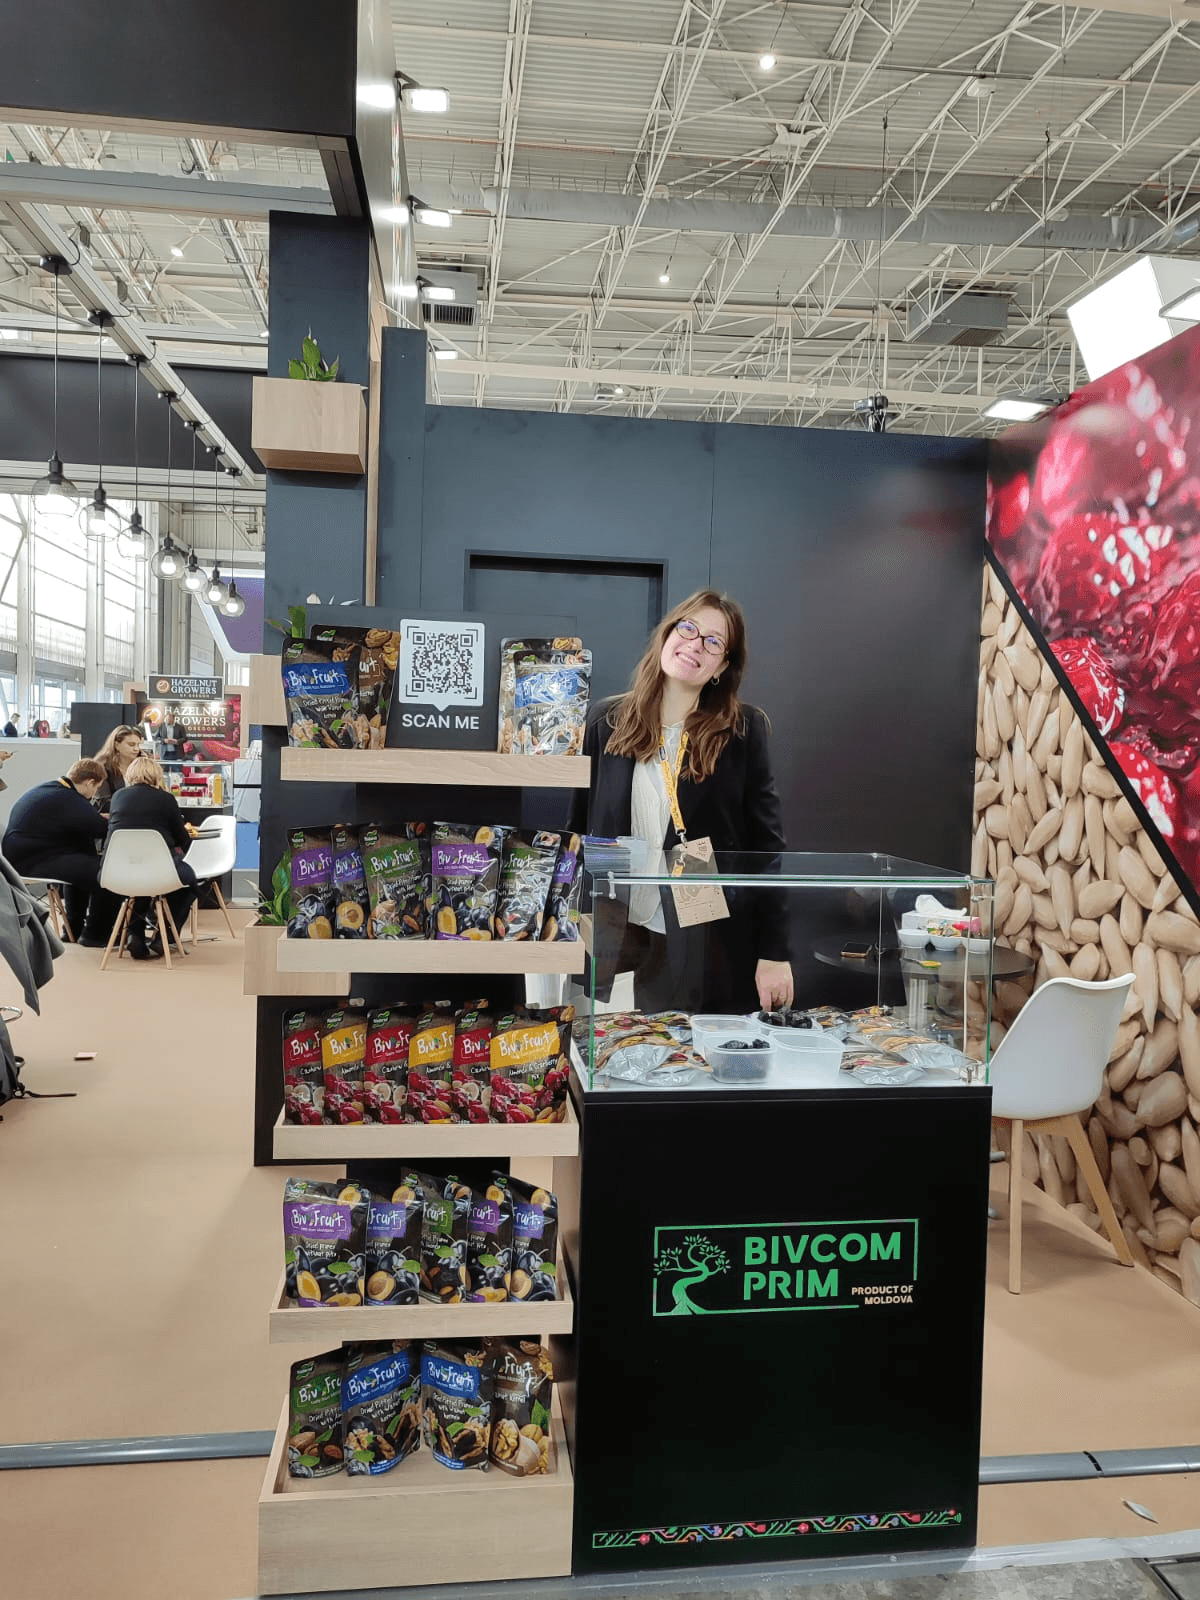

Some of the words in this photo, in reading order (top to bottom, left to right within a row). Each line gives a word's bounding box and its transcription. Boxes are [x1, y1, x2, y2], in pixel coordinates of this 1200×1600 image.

[360, 657, 377, 673] uit
[171, 678, 218, 688] HAZELNUT
[312, 669, 339, 684] Fruit
[171, 686, 217, 695] GROWERS
[164, 706, 227, 716] HAZELNUT
[402, 713, 450, 729] SCAN
[455, 716, 480, 730] ME
[393, 848, 414, 864] Fruit
[457, 849, 482, 864] Fruit
[510, 853, 533, 868] Fruit
[523, 1030, 550, 1050] Fruit
[314, 1210, 343, 1227] Fruit
[370, 1208, 398, 1225] Fruit
[423, 1202, 446, 1221] Fruit
[473, 1205, 493, 1220] ruit
[744, 1232, 901, 1265] BIVCOM
[743, 1269, 839, 1300] PRIM
[851, 1286, 900, 1295] PRODUCT
[901, 1285, 914, 1294] OF
[864, 1295, 914, 1305] MOLDOVA
[372, 1361, 400, 1384] Fruit
[505, 1356, 533, 1377] Fruit
[325, 1376, 341, 1393] Fru
[447, 1366, 473, 1387] Fruit
